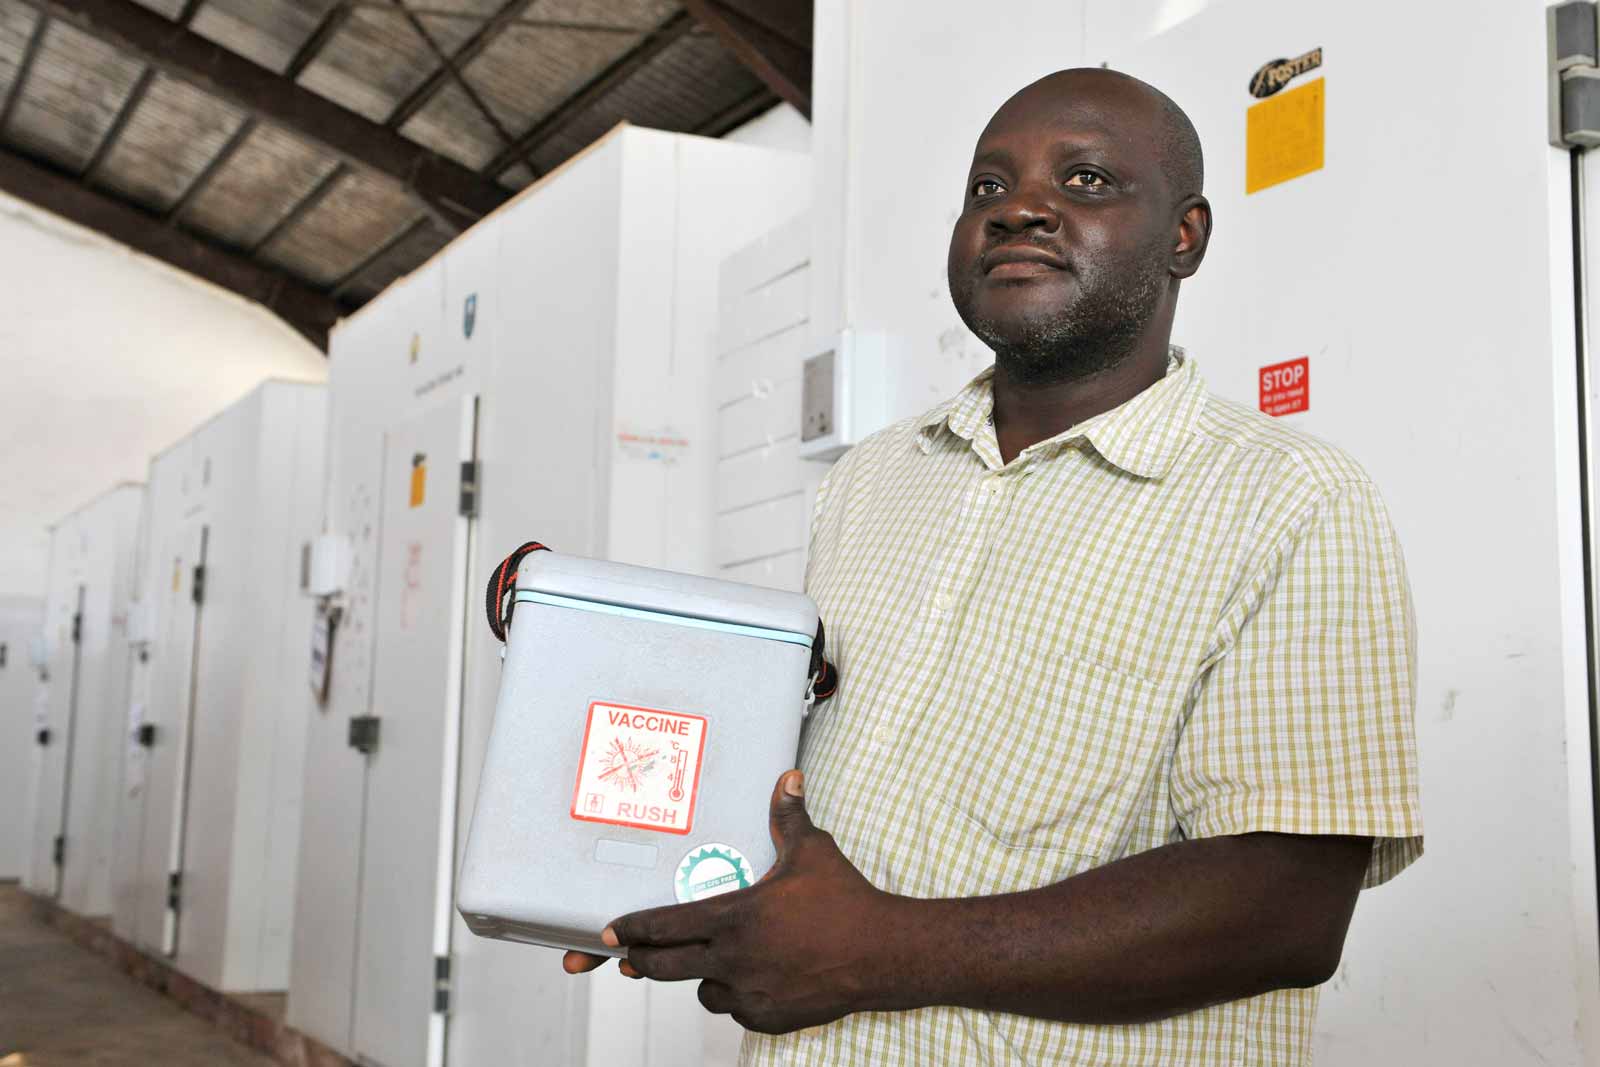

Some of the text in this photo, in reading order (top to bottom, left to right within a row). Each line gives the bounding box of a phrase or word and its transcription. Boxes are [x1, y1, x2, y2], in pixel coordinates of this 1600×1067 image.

[1267, 51, 1321, 87] FOSTER
[1263, 364, 1304, 392] STOP
[608, 710, 691, 736] VACCINE
[617, 802, 677, 824] RUSH
